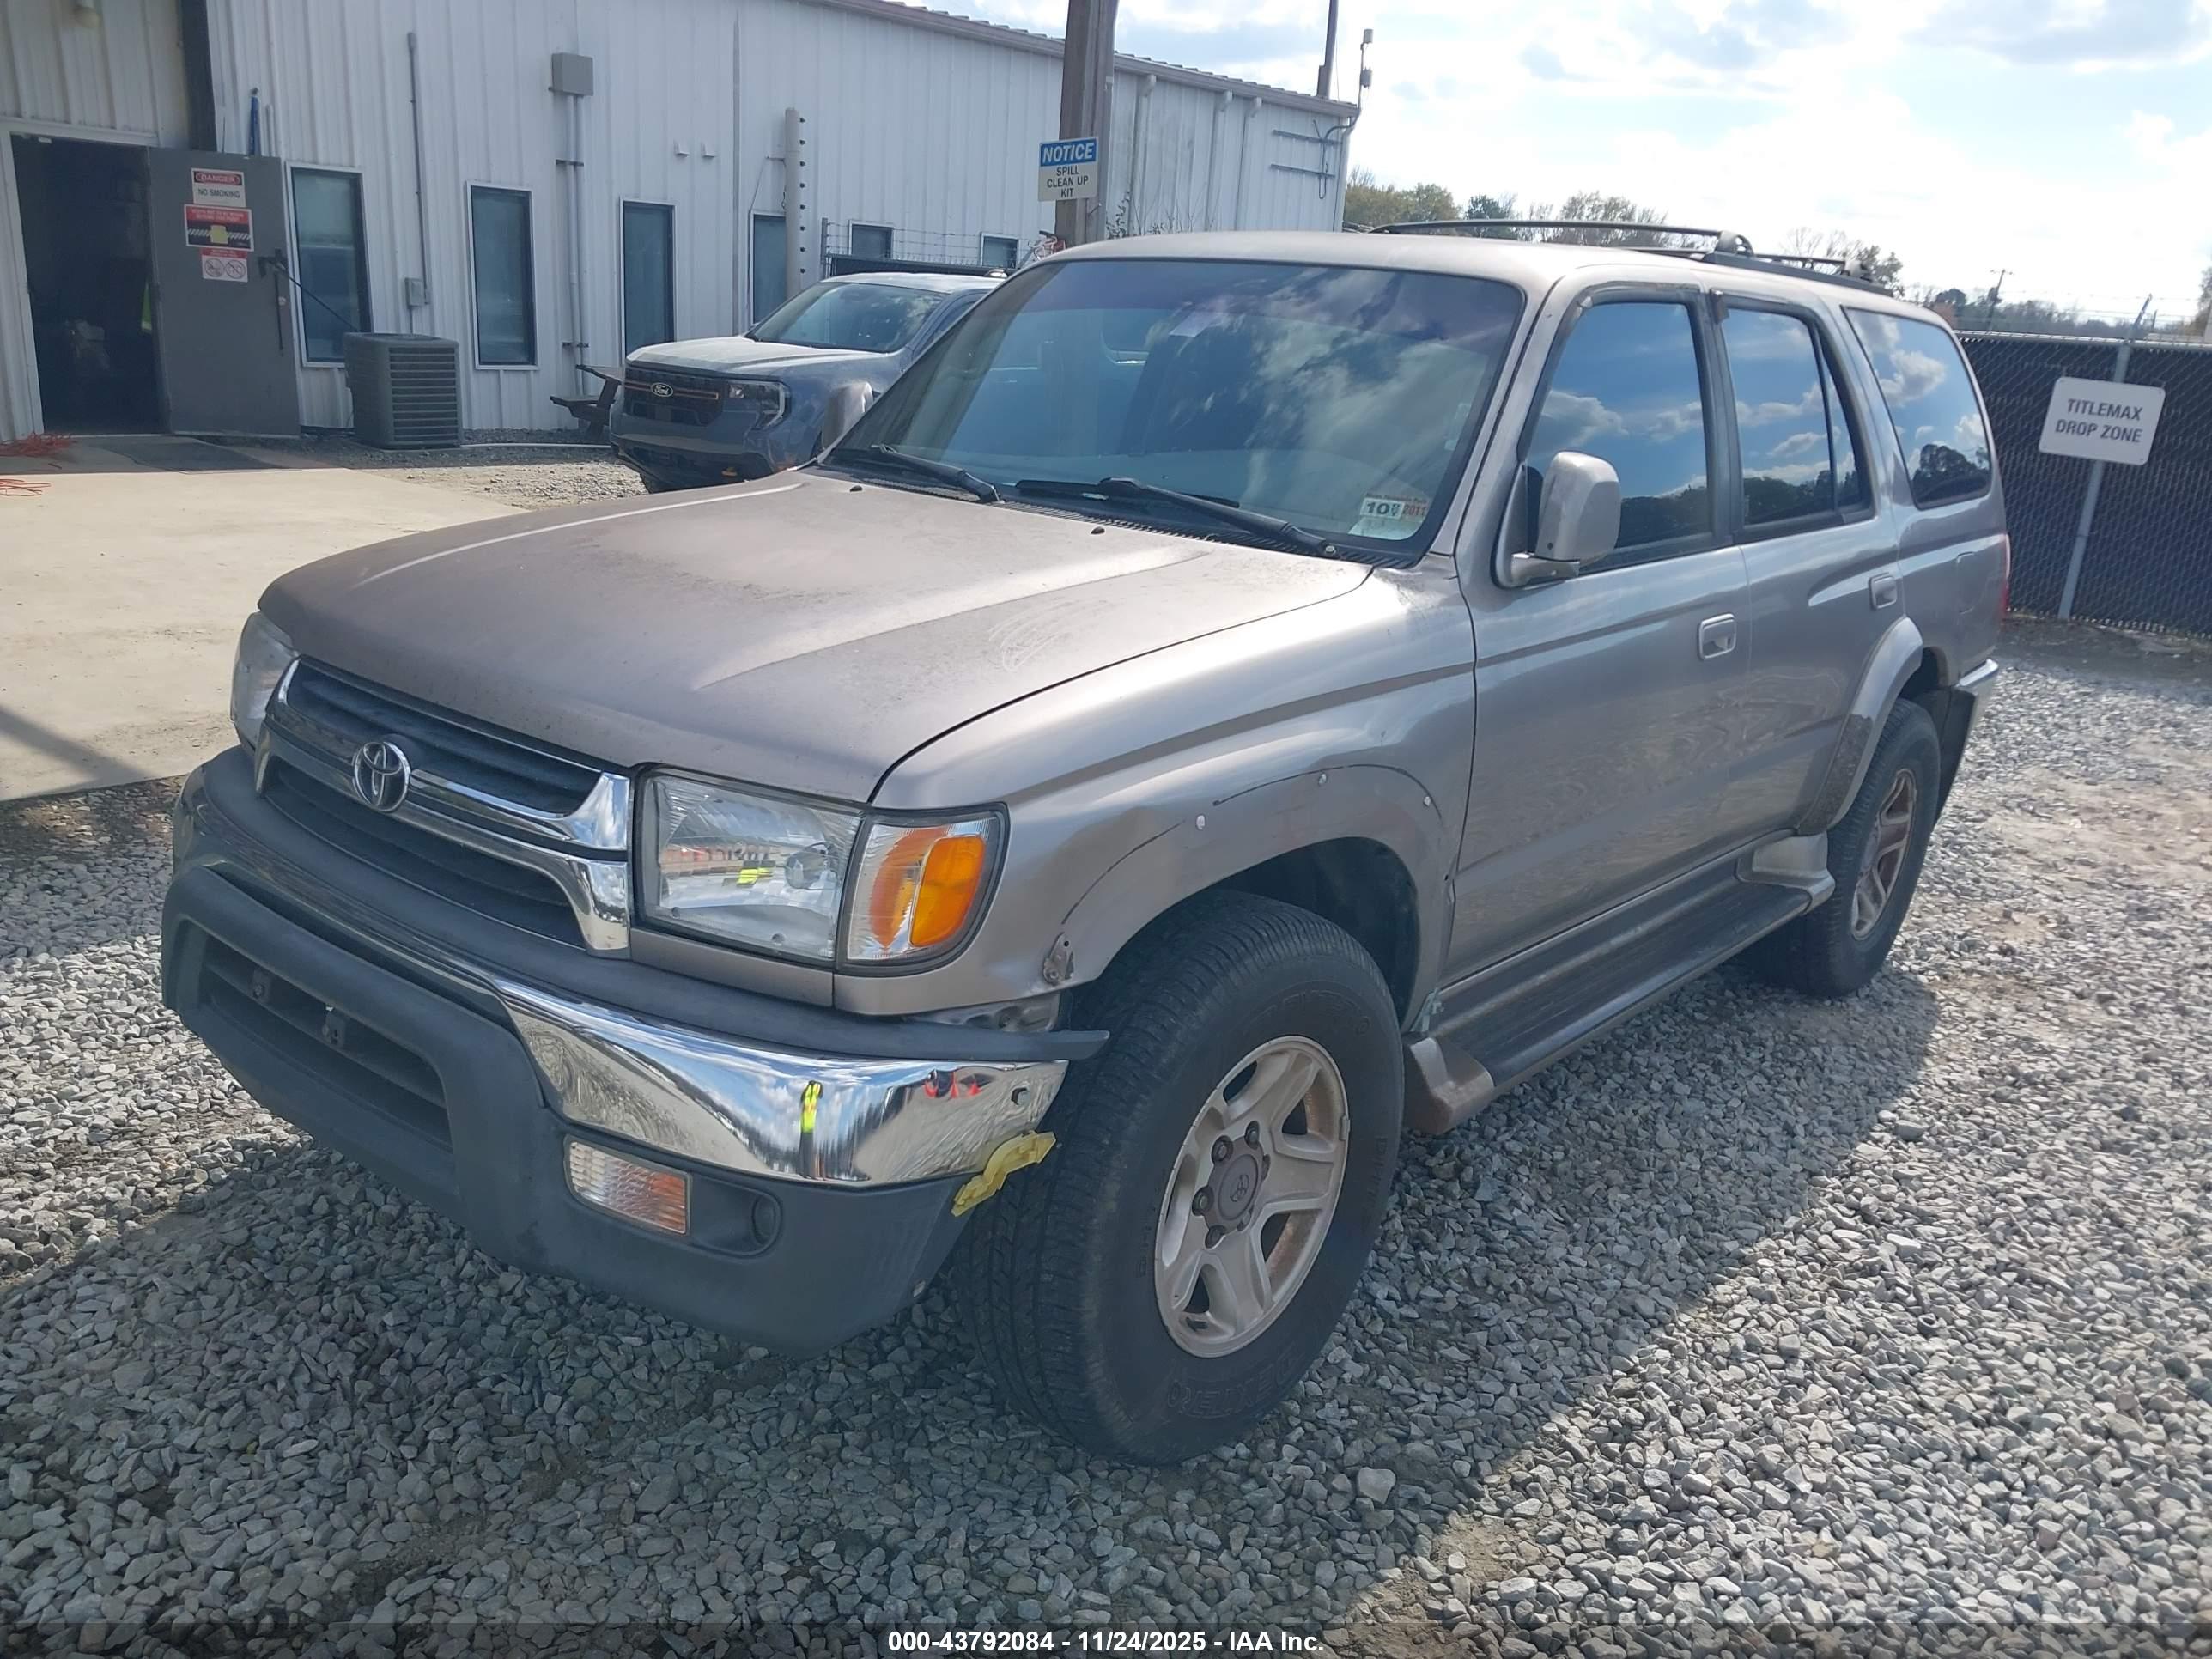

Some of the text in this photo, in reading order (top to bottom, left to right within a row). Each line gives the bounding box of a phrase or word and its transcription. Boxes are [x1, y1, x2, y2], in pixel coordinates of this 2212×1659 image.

[1042, 143, 1095, 163] NOTICE
[1056, 165, 1079, 176] SPILL
[1047, 175, 1089, 188] CLEAN UP
[198, 188, 240, 198] NO SMOKING
[1060, 188, 1074, 198] KIT
[2068, 398, 2143, 421] TITLEMAX
[2055, 419, 2143, 442] DROP ZONE
[1367, 501, 1390, 515] 10
